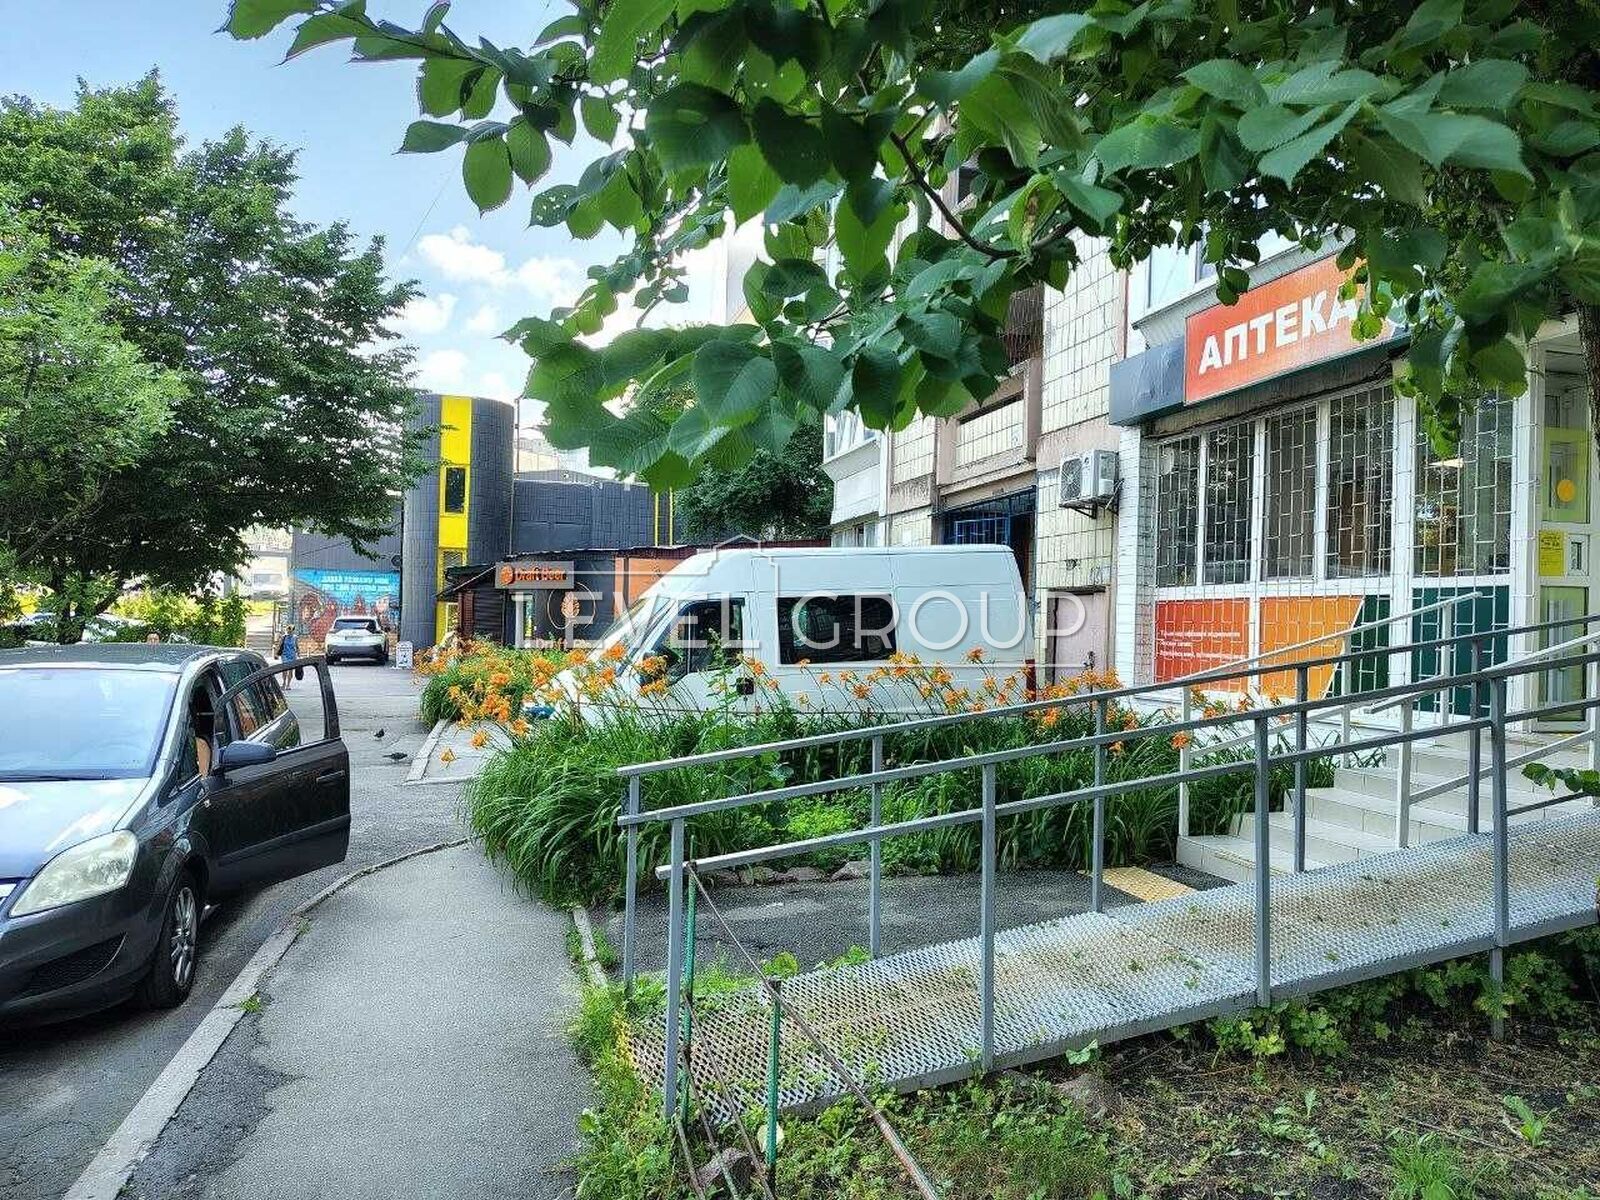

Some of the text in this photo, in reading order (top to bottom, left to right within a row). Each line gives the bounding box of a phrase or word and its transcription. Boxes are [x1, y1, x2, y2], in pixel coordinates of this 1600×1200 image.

[1199, 282, 1358, 375] АПТЕКА
[515, 567, 567, 581] Draft Beer
